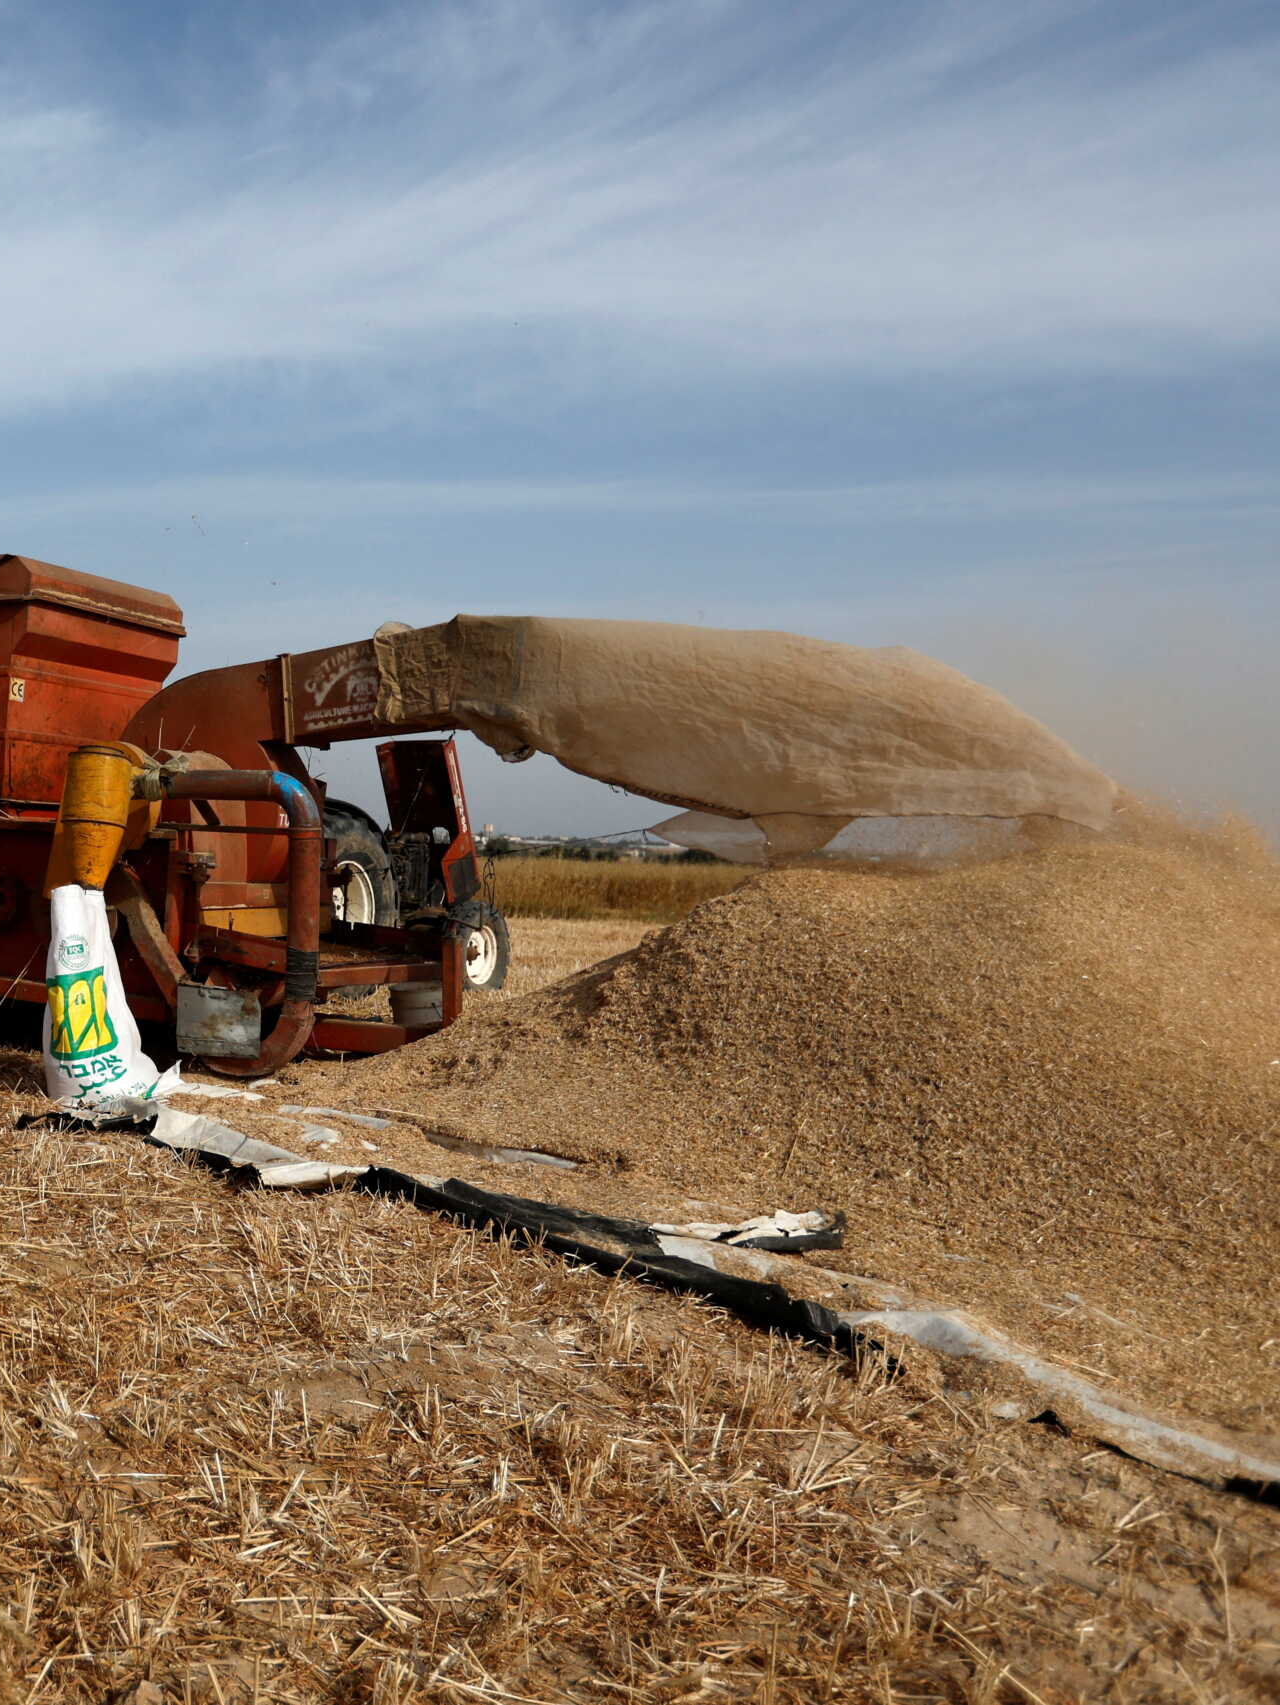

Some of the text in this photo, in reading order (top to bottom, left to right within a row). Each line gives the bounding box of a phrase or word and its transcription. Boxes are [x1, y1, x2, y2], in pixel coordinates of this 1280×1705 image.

[11, 682, 24, 698] CE
[59, 1054, 122, 1078] אמבר
[72, 1065, 128, 1099] عنبر
